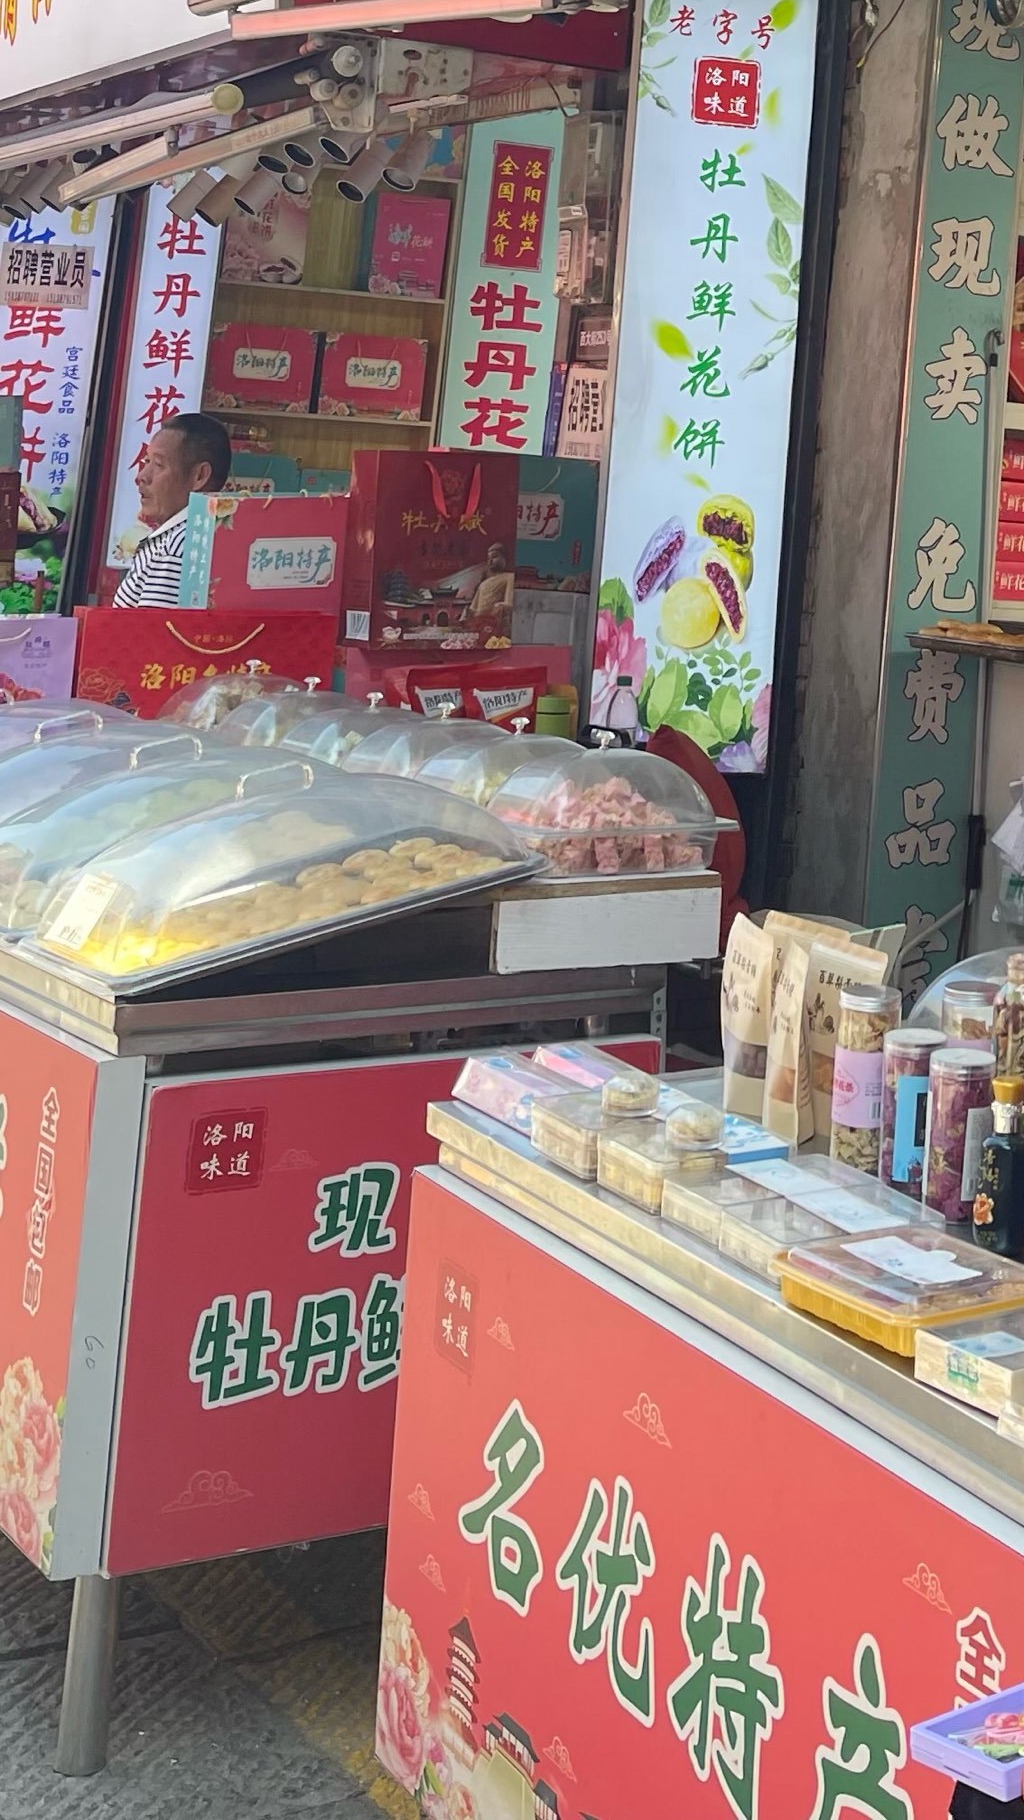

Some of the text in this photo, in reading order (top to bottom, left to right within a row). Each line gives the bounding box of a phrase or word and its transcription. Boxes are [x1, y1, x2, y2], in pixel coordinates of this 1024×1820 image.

[669, 4, 776, 50] 老字号
[704, 66, 750, 88] 洛阳
[703, 95, 750, 118] 味道
[491, 156, 519, 258] 全国发货
[514, 159, 547, 257] 洛阳特产
[6, 247, 87, 289] 招聘营业员
[673, 147, 748, 470] 牡丹鲜花饼
[458, 280, 543, 450] 牡丹花
[251, 543, 335, 584] 洛阳特产
[203, 1120, 254, 1147] 洛阳
[200, 1151, 252, 1181] 味道
[22, 1086, 61, 1316] 全国包邮
[311, 1164, 398, 1257] 现
[444, 1275, 472, 1312] 洛阳
[441, 1312, 469, 1358] 味道
